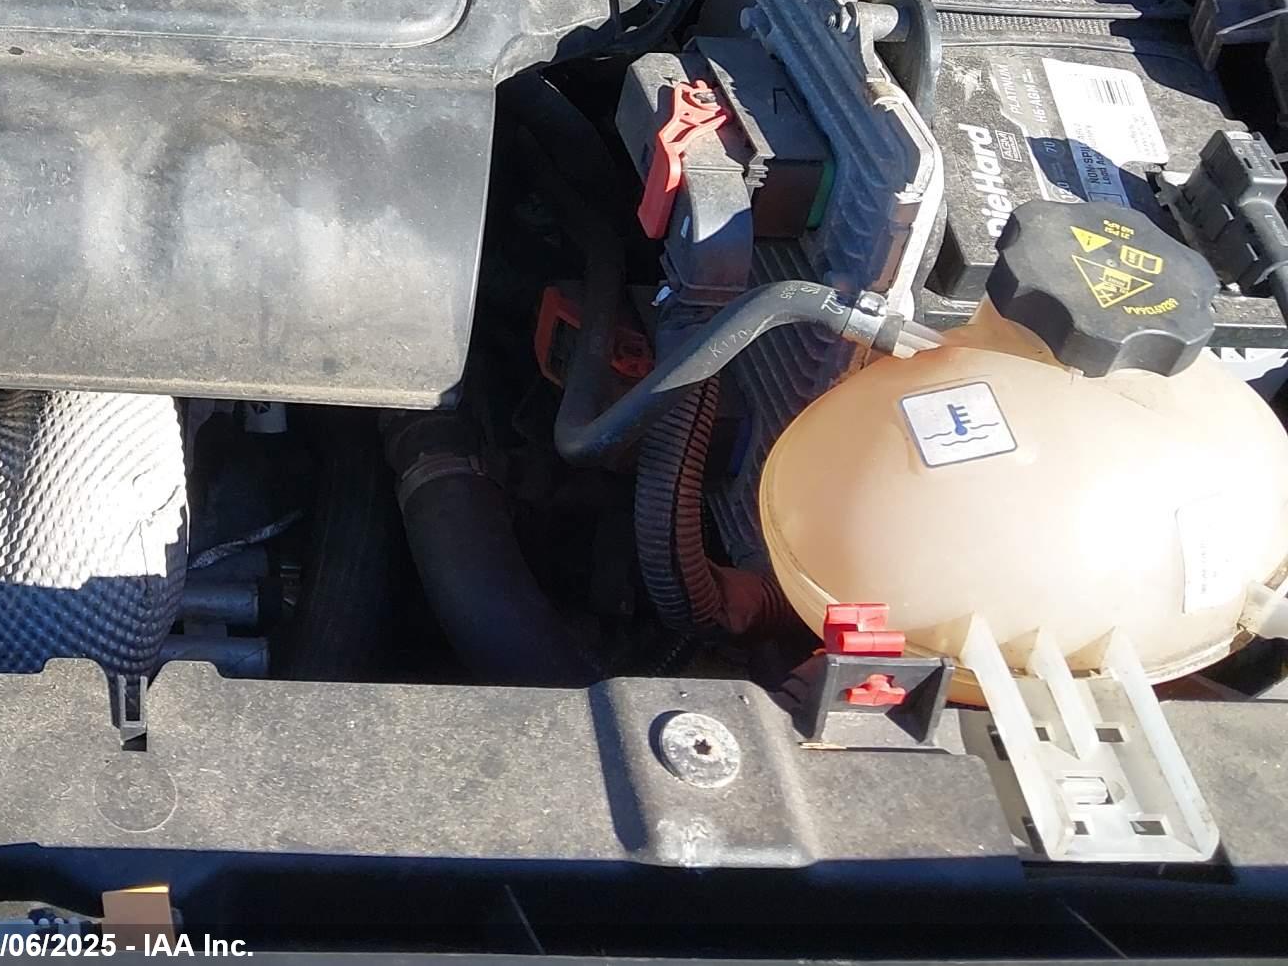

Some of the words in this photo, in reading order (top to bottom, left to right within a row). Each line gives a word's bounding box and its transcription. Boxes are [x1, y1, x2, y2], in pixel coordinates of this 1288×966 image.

[1000, 64, 1024, 115] PLATINUM
[1001, 133, 1013, 159] AGM
[958, 123, 1013, 238] DieHard
